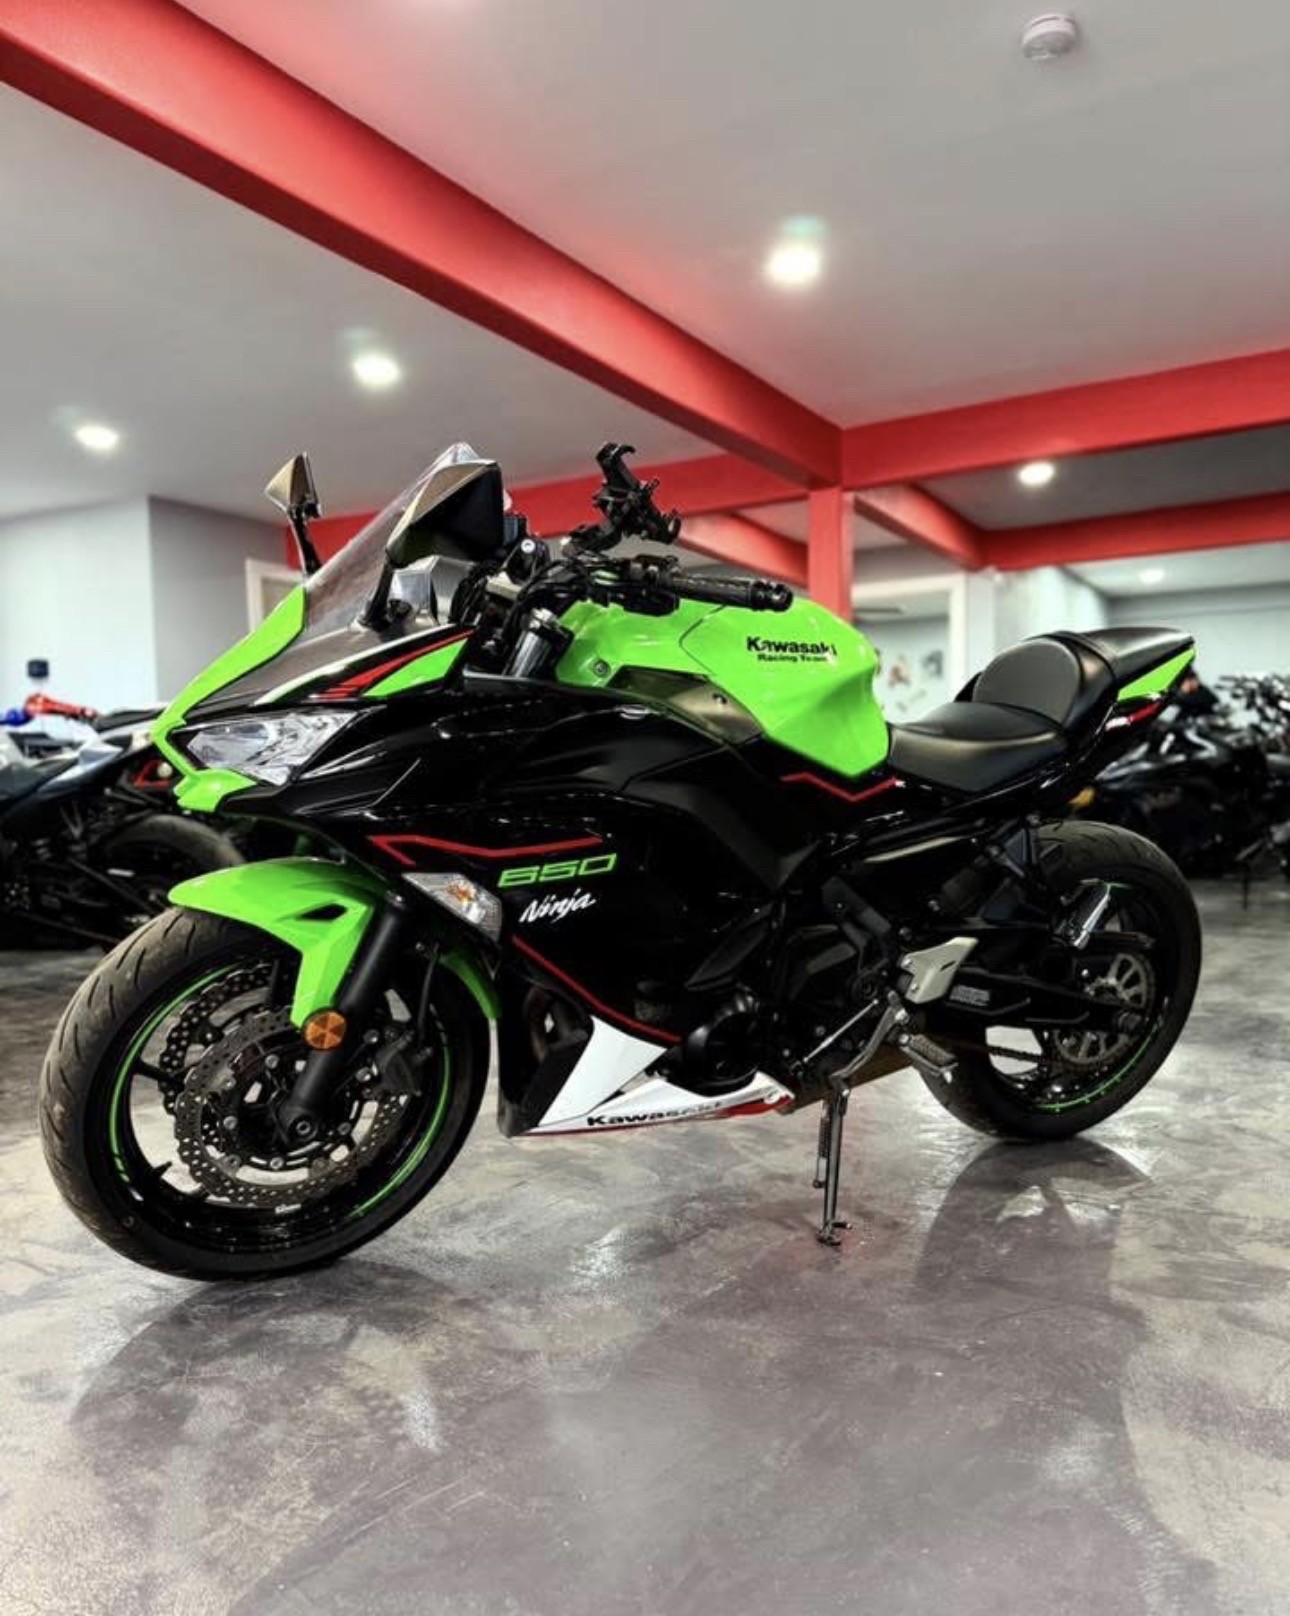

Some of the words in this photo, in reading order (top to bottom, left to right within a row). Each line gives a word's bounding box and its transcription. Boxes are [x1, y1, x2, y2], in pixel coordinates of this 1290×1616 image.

[747, 636, 838, 656] Kawasaki
[757, 653, 798, 663] Racing
[498, 853, 617, 888] 650
[519, 888, 597, 923] Ninja
